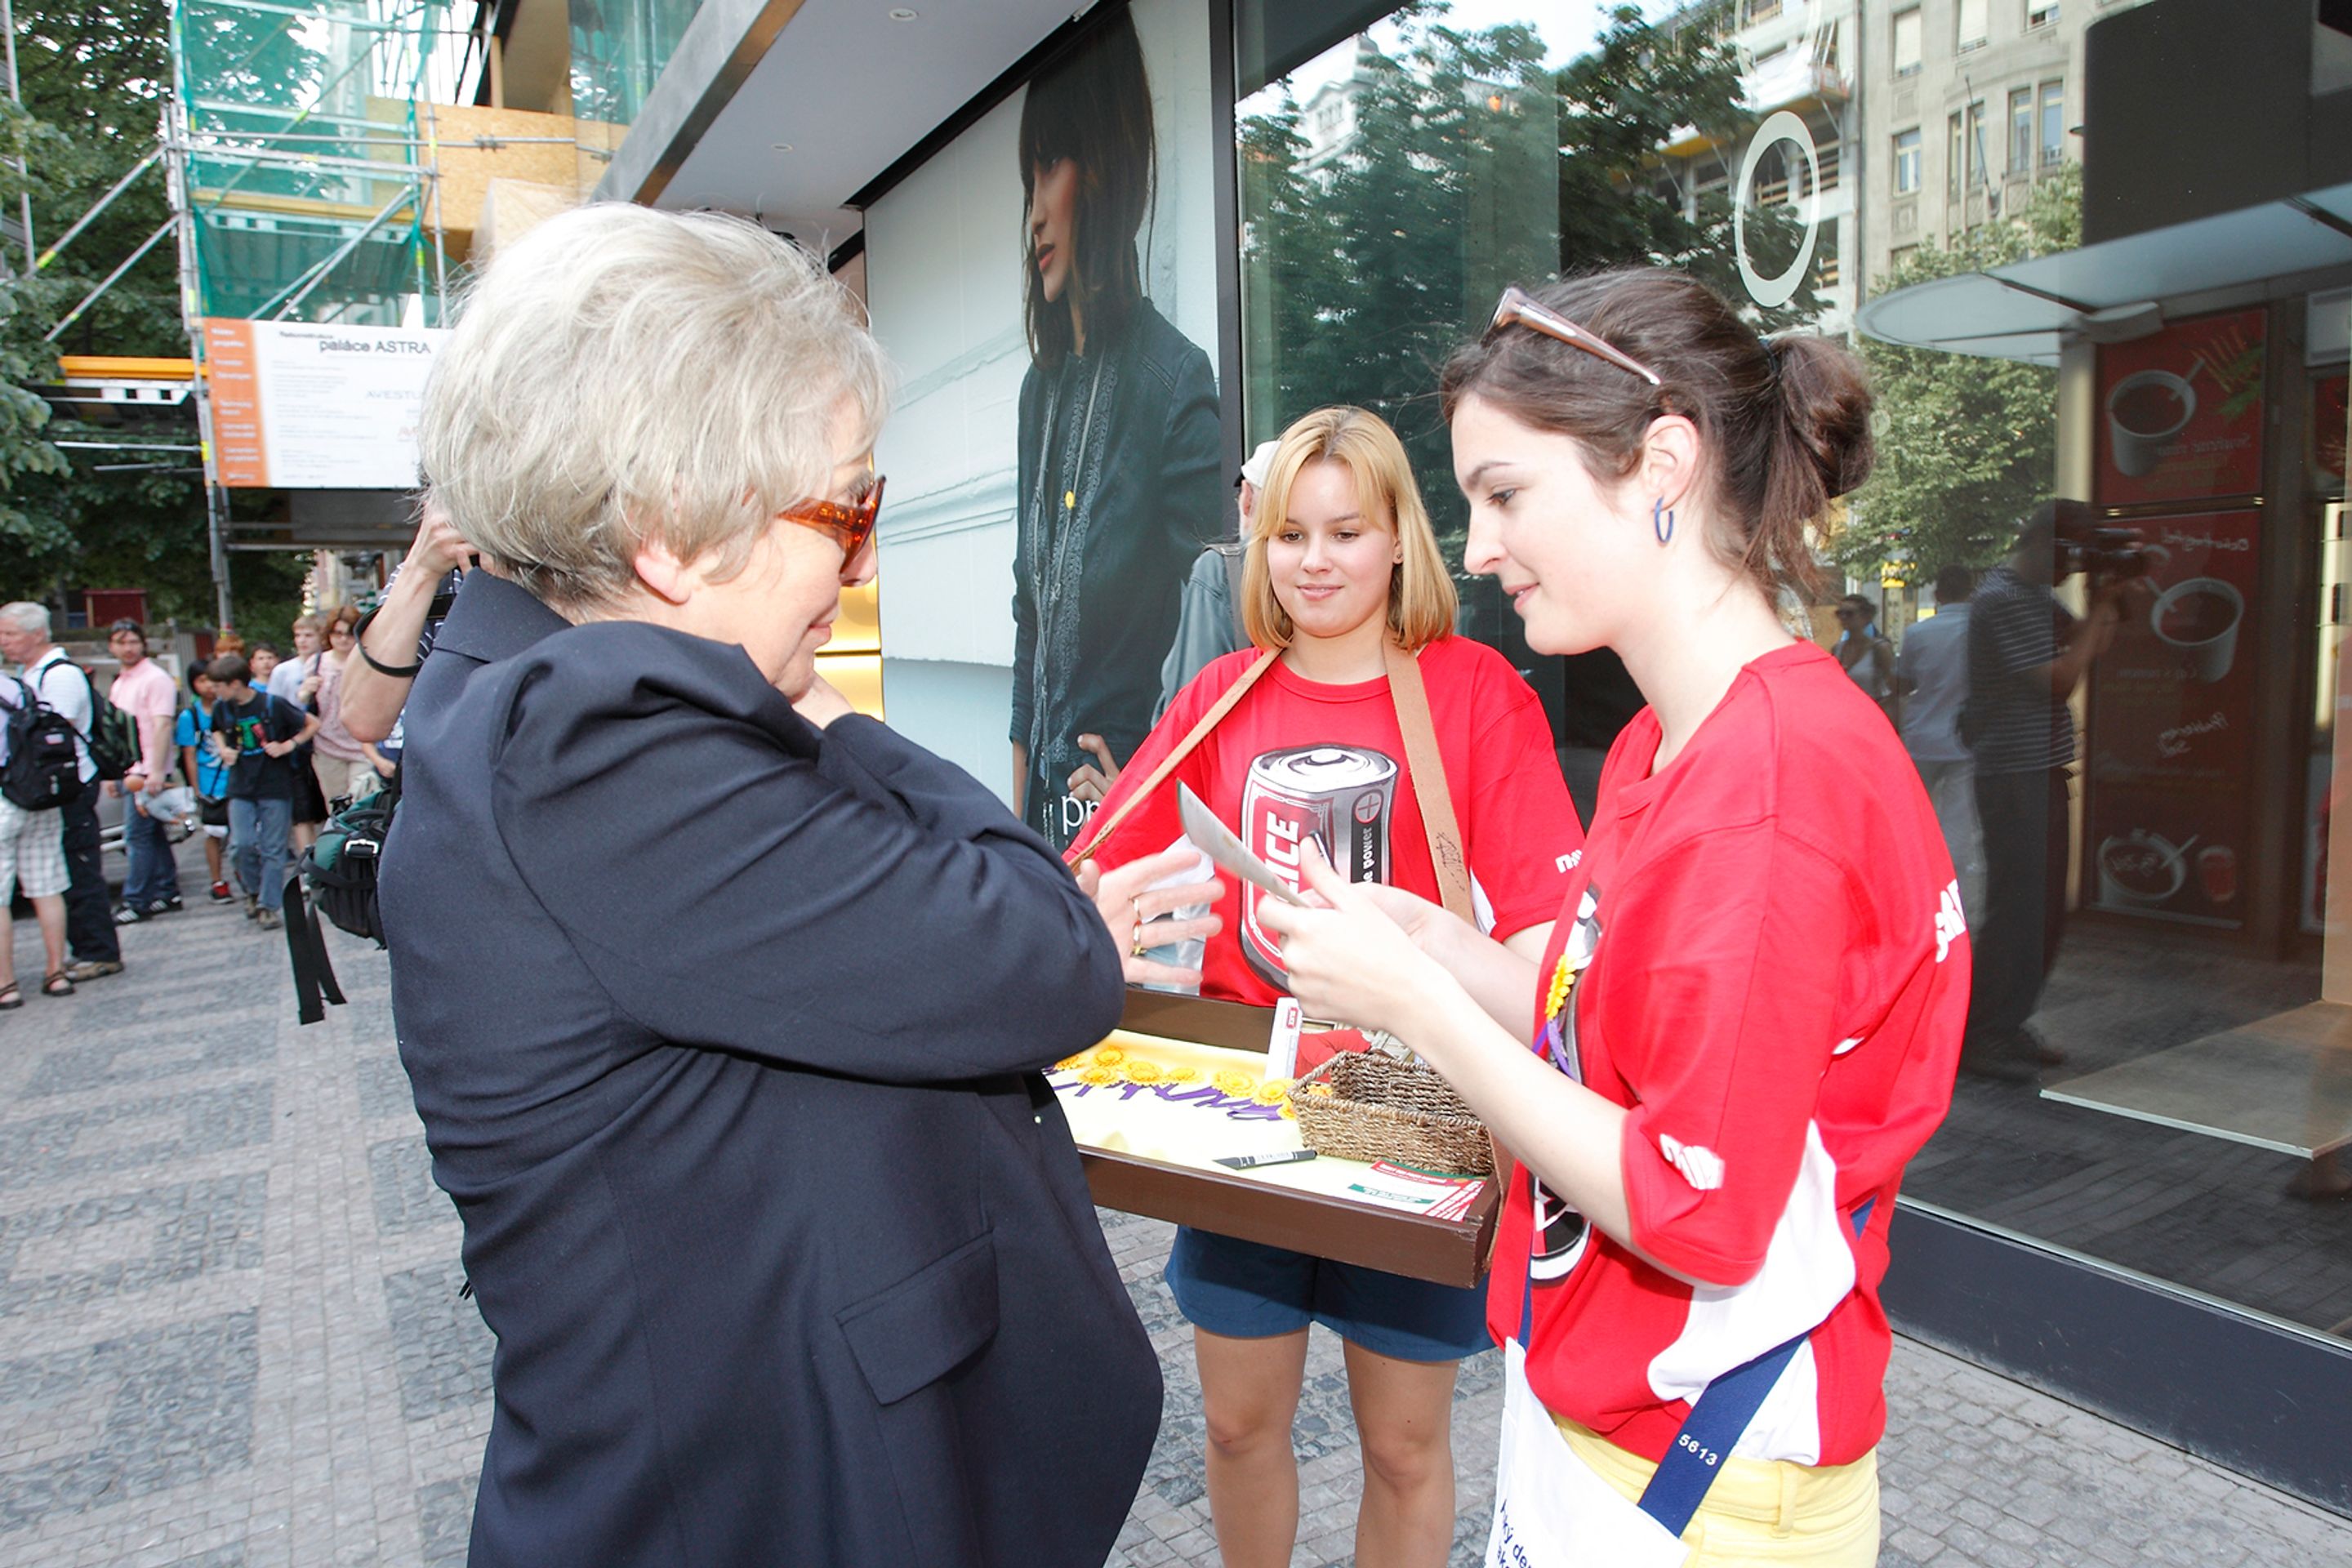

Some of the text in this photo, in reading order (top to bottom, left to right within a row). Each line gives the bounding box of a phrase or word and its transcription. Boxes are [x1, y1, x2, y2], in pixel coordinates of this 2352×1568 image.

[375, 340, 431, 354] ASTRA
[1362, 826, 1375, 870] power
[1678, 1433, 1718, 1466] 5613
